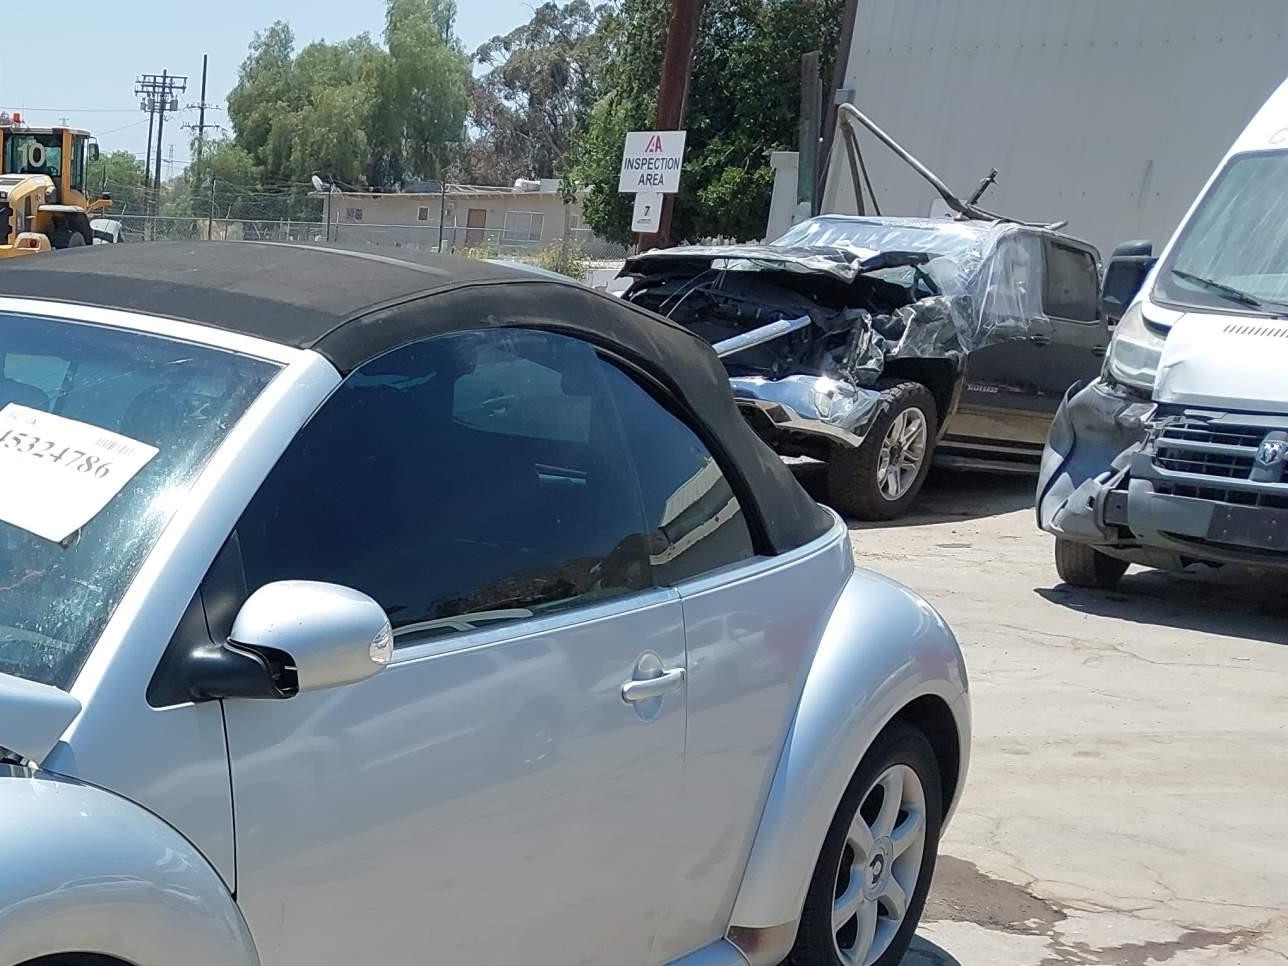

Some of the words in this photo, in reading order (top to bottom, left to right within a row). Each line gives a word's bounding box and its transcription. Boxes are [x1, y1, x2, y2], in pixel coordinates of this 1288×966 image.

[18, 143, 46, 168] 10
[624, 157, 680, 170] INSPECTION
[638, 173, 664, 186] AREA
[644, 205, 651, 217] 7
